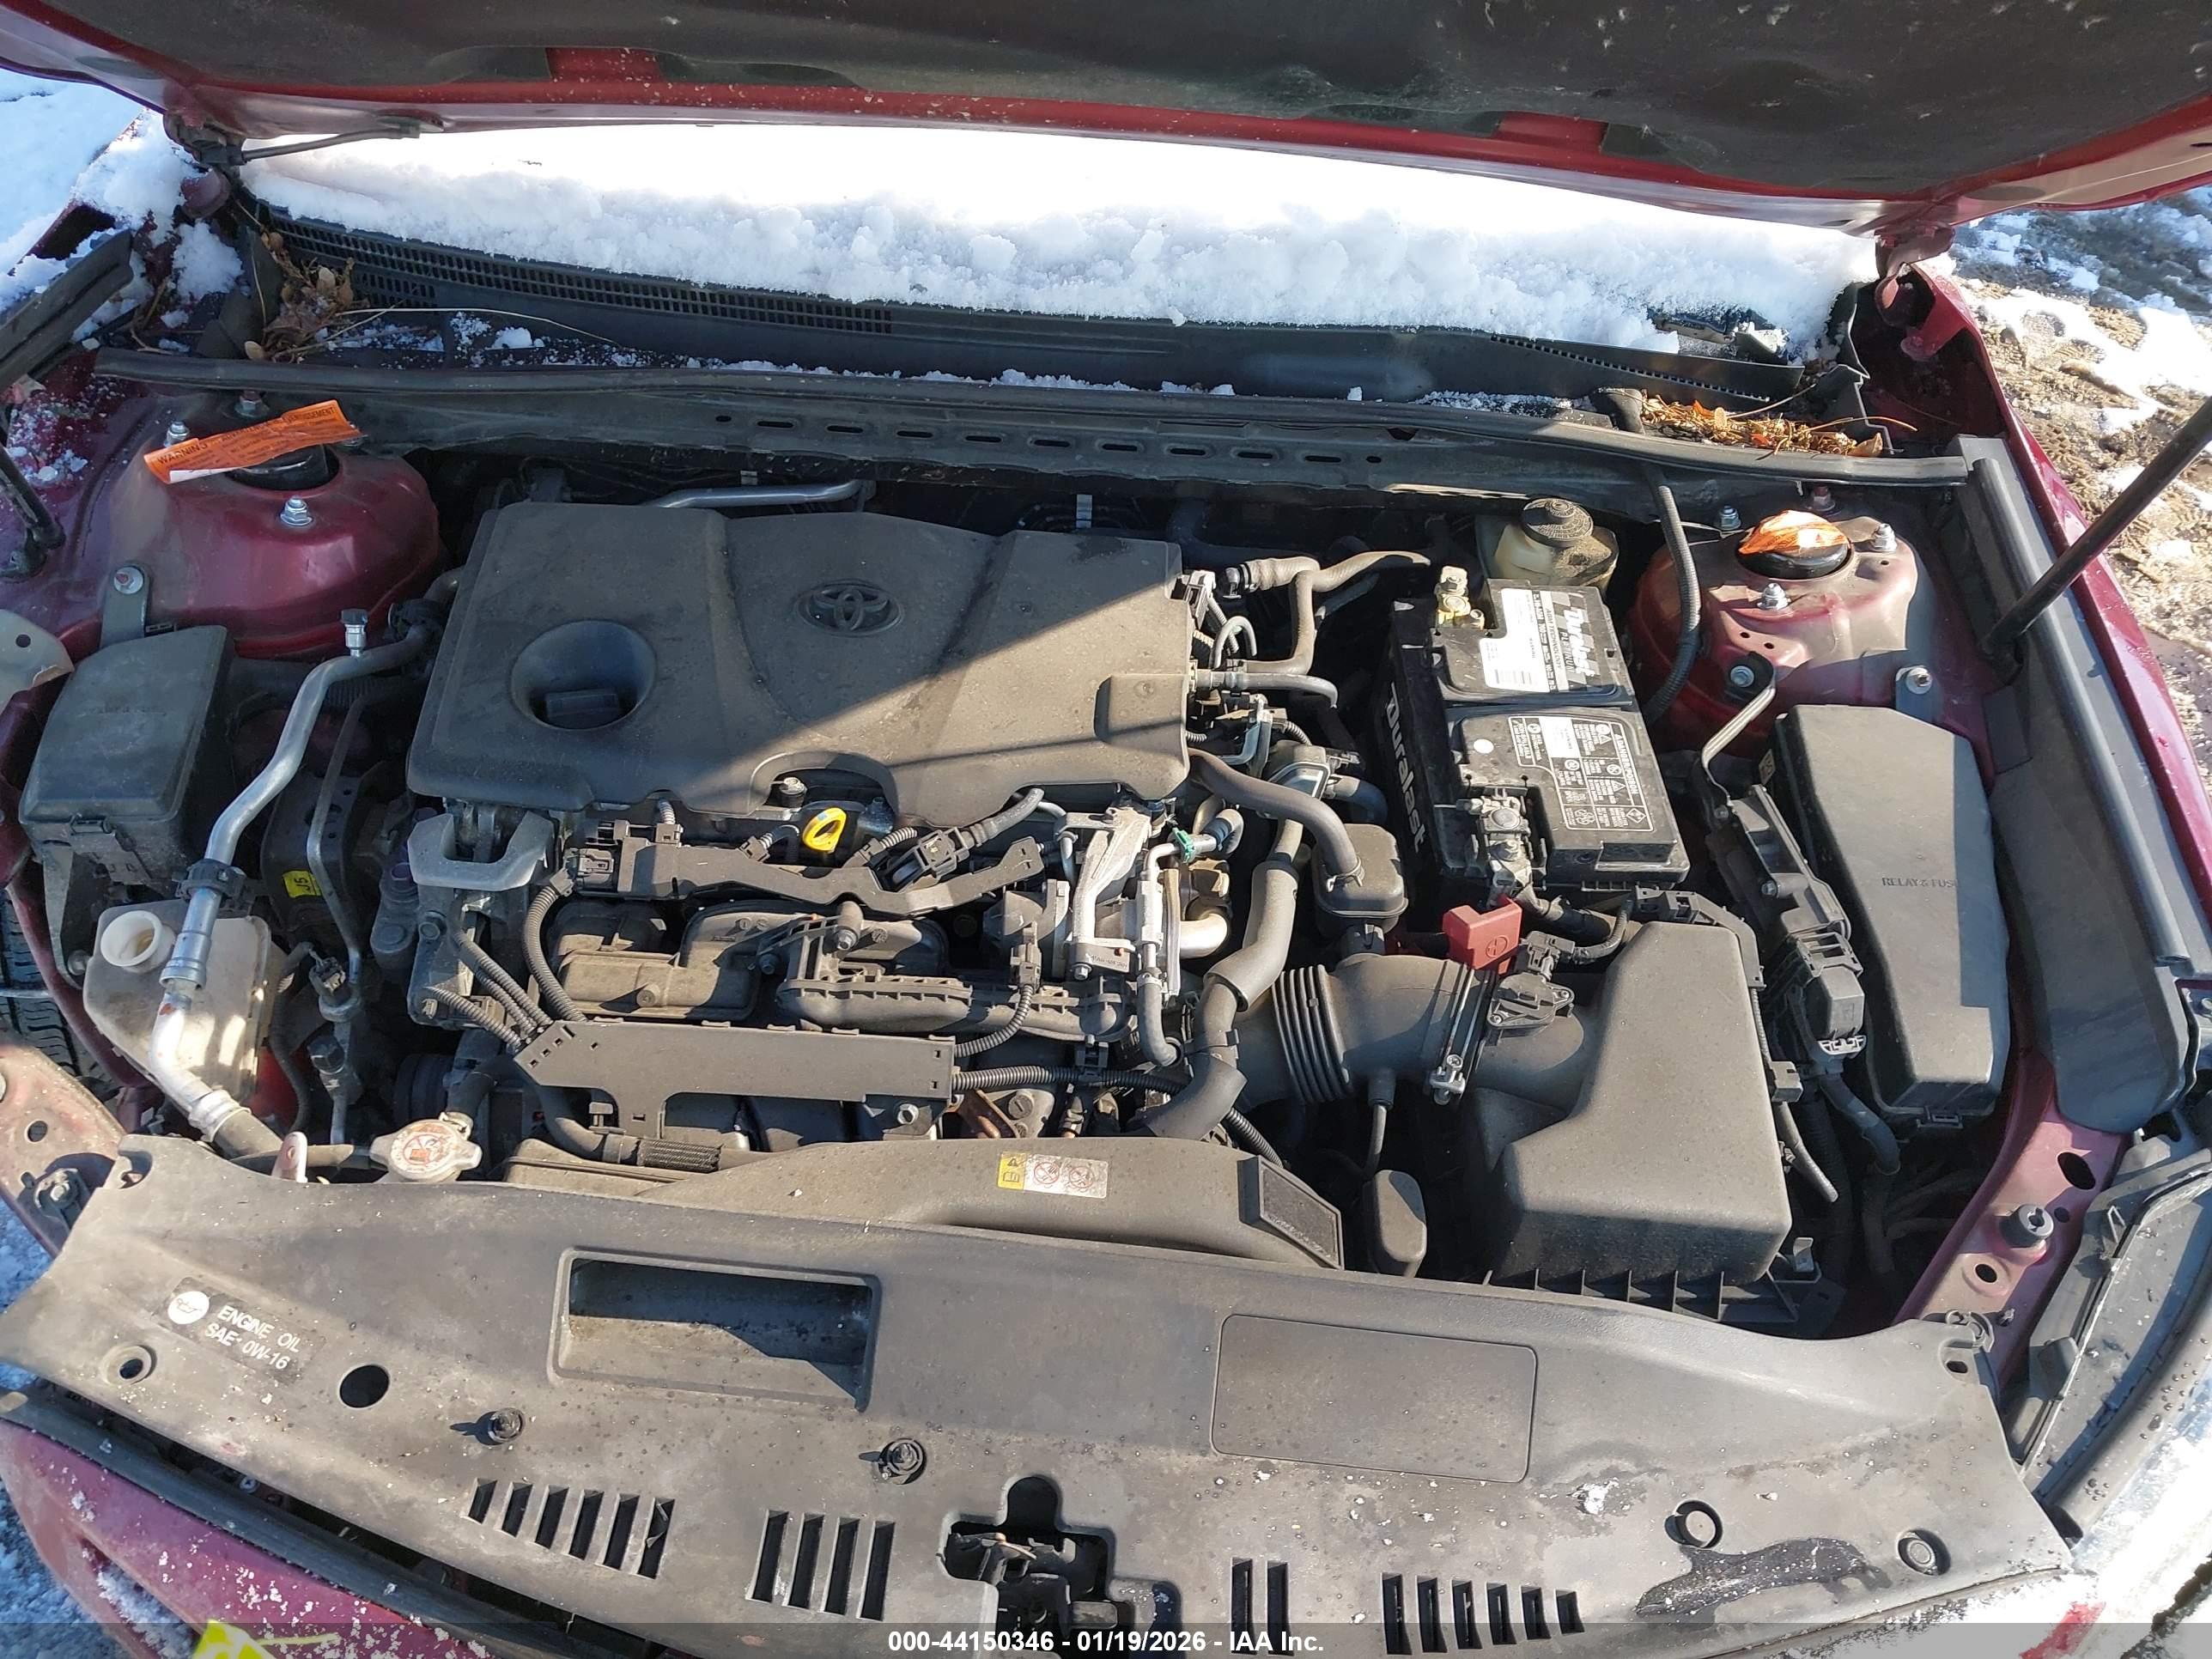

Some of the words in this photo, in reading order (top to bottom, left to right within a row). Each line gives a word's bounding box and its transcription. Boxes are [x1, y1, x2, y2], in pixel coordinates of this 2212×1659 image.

[1564, 608, 1595, 678] Duralast
[1386, 682, 1425, 853] Duralast
[1882, 878, 1917, 886] RELAY
[217, 1305, 275, 1338] ENGINE
[277, 1333, 301, 1352] OIL
[242, 1340, 290, 1370] 0W-16
